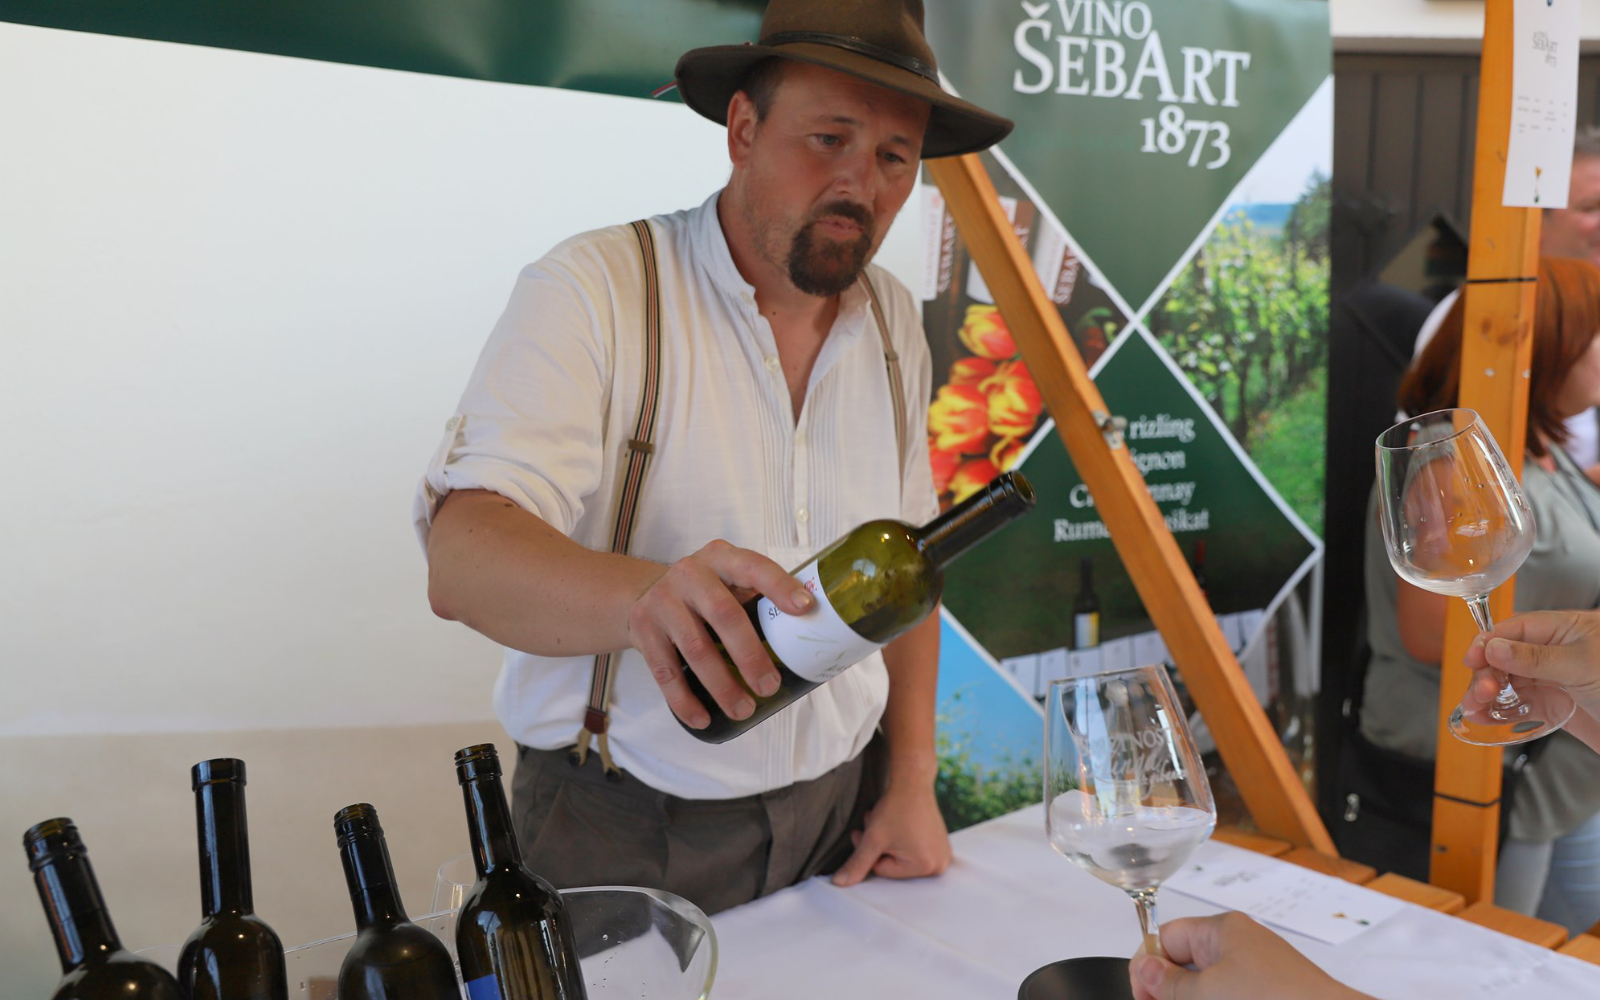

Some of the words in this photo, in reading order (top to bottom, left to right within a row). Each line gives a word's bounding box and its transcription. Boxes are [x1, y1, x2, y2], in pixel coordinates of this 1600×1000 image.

[1055, 0, 1153, 40] VINO
[1140, 104, 1231, 170] 1873
[1129, 413, 1196, 443] rizling
